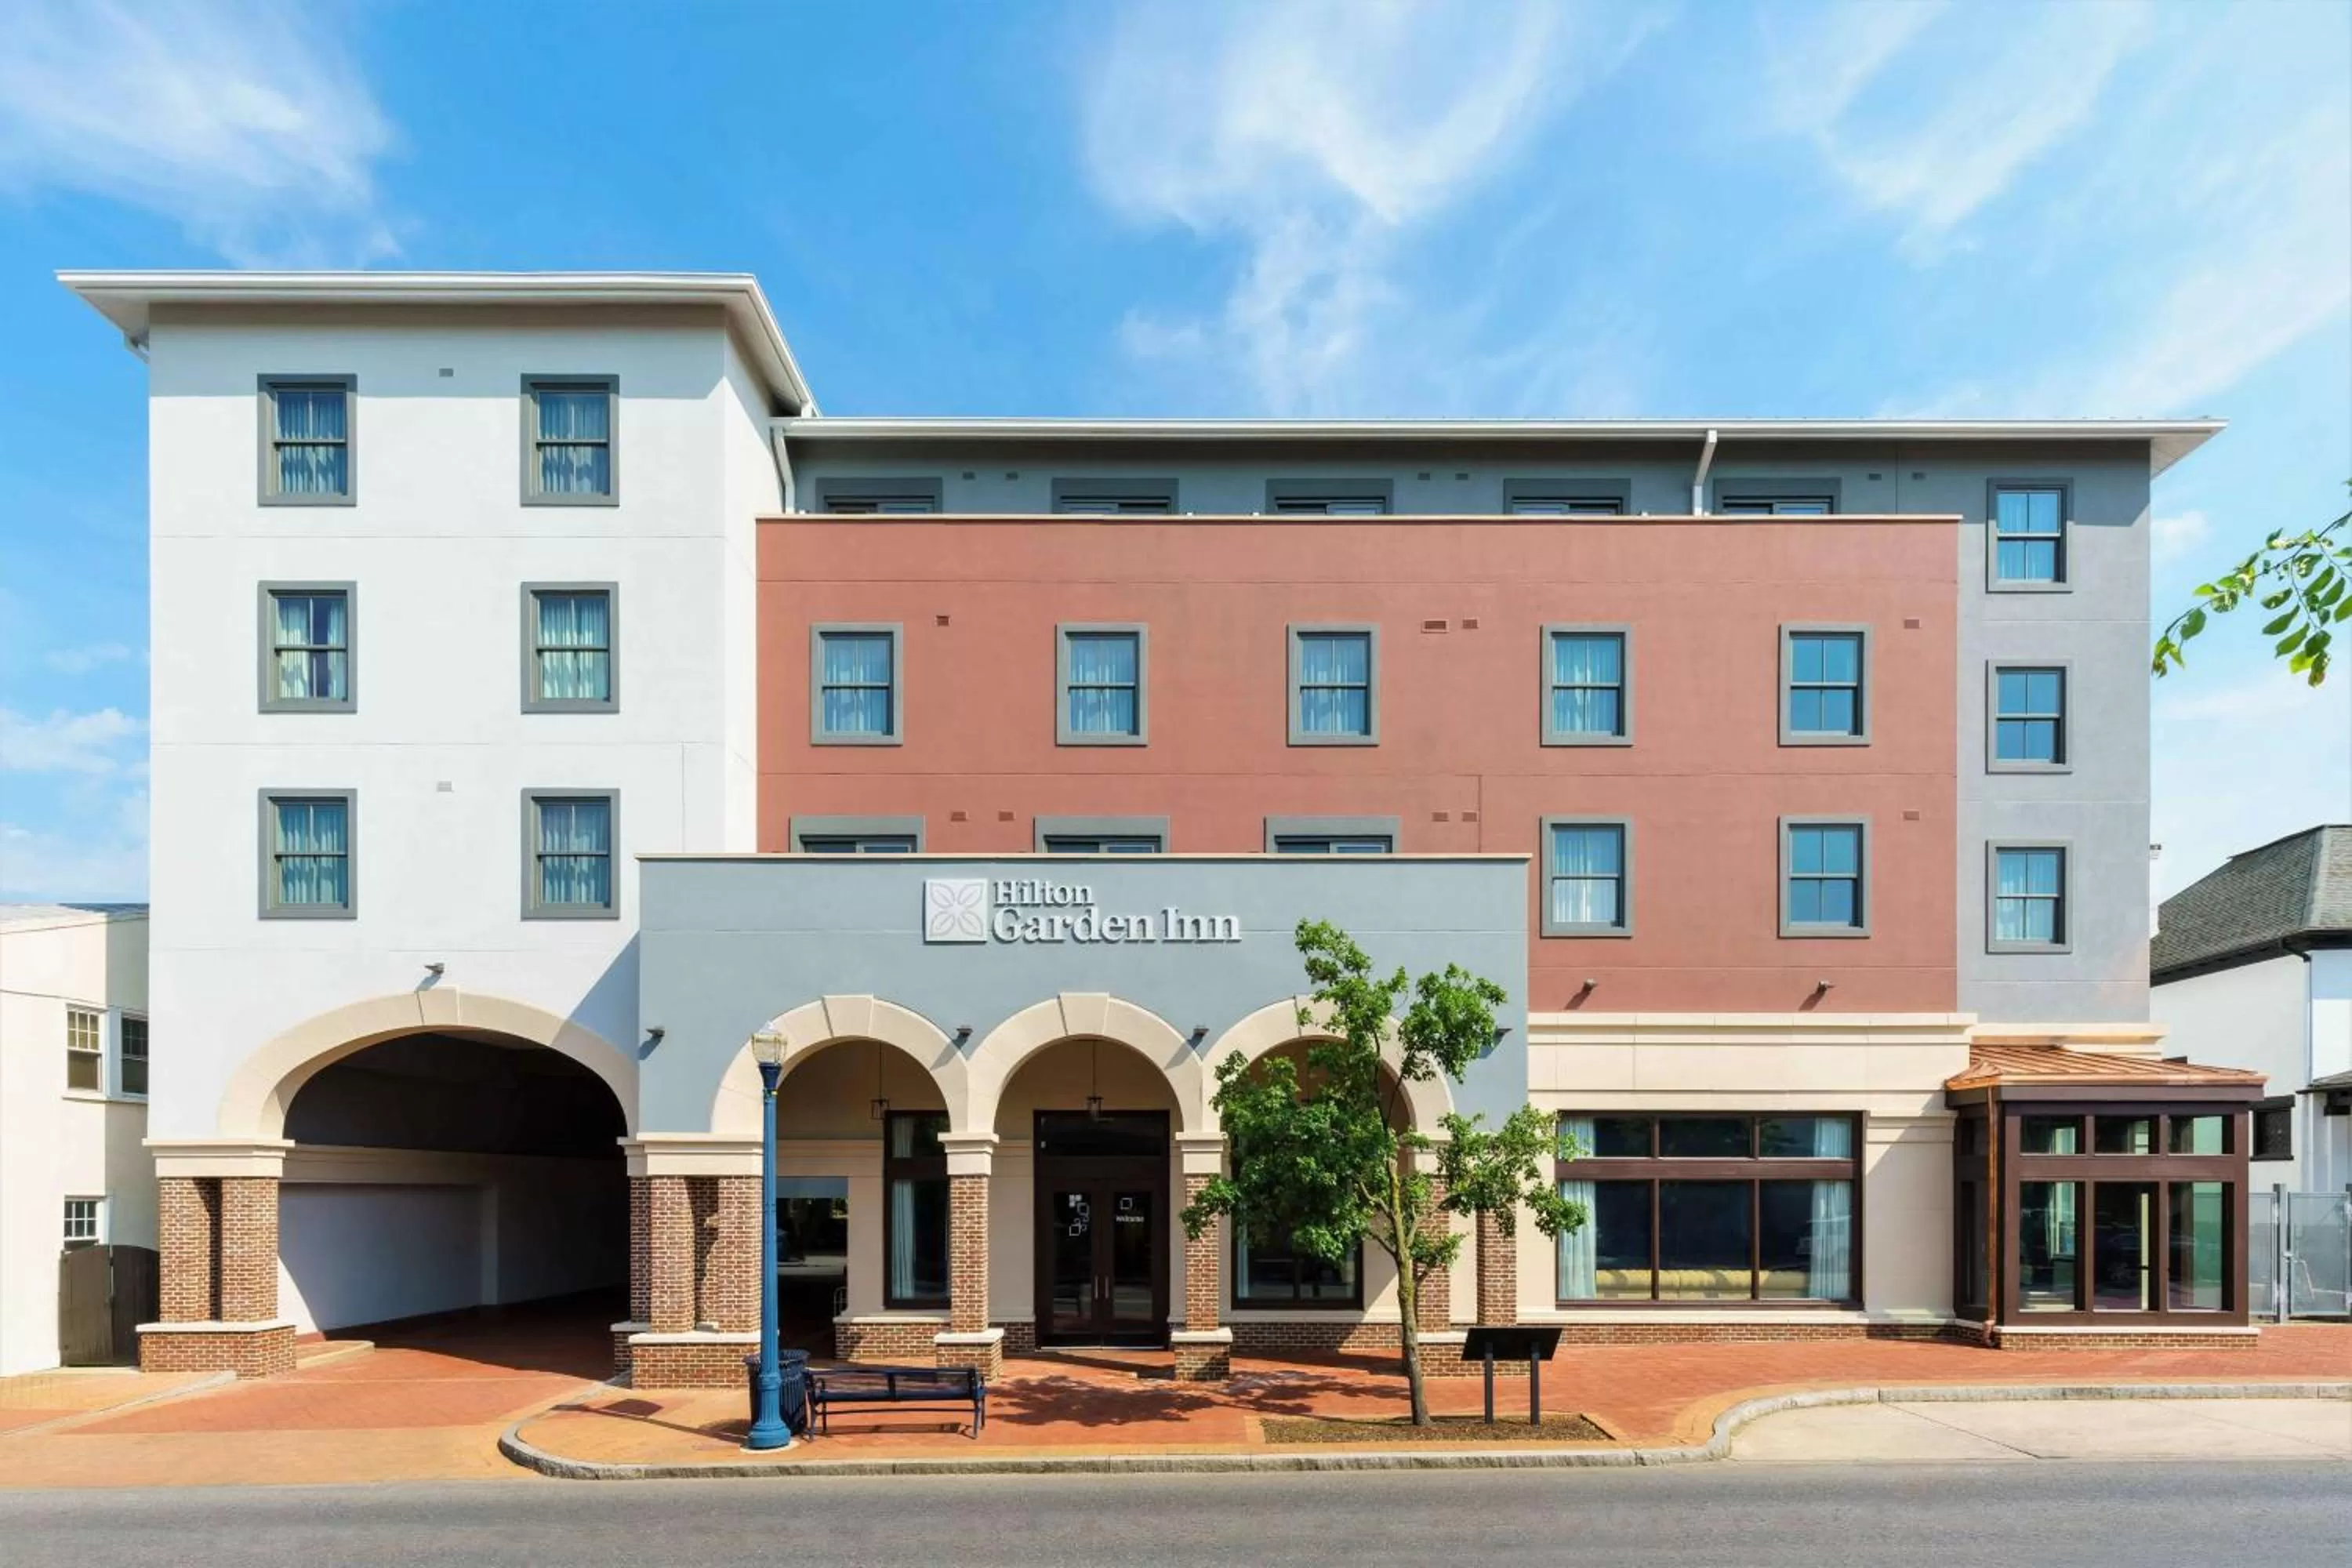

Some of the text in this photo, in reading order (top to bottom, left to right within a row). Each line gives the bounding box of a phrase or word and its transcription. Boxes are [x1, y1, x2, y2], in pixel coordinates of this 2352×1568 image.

[995, 879, 1094, 906] Hilton
[993, 906, 1242, 942] Garden Inn
